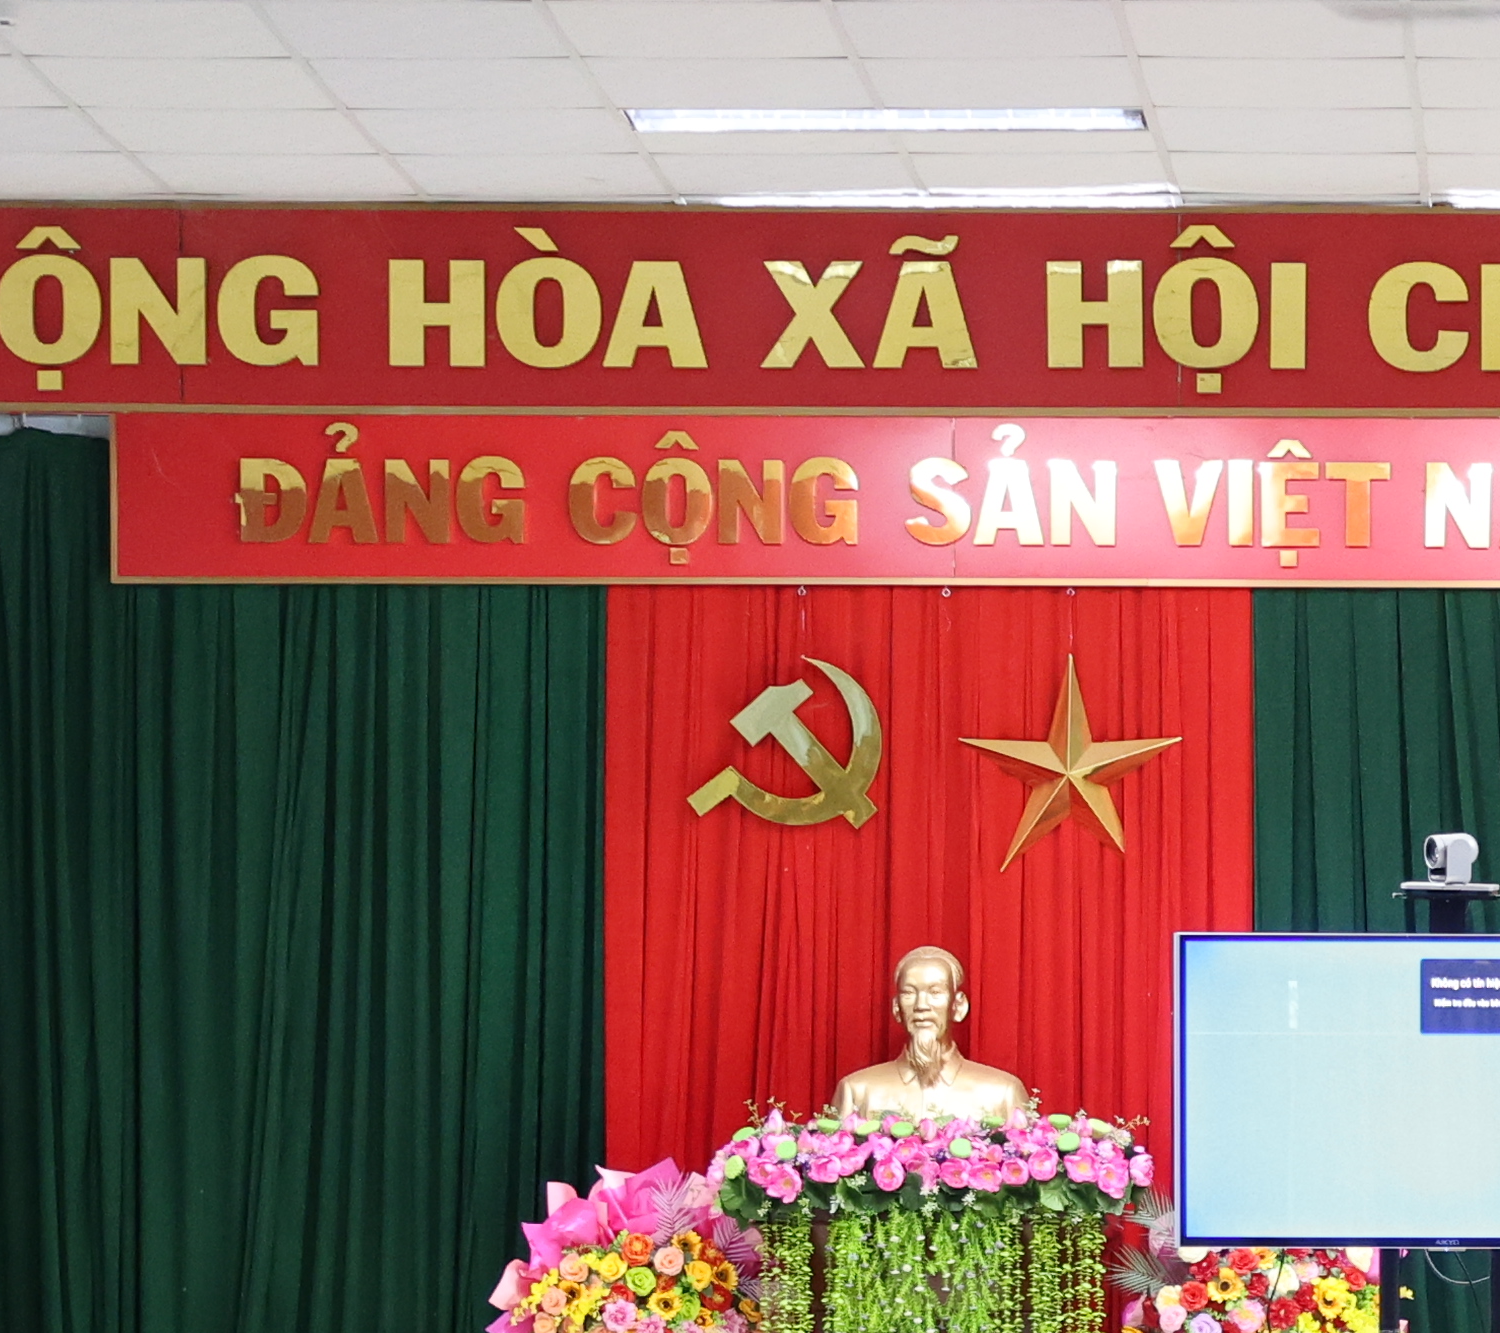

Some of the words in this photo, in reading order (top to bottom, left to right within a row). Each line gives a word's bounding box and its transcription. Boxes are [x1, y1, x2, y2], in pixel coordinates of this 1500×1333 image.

[388, 226, 704, 369] HÒA
[760, 234, 978, 369] XÃ
[1045, 224, 1307, 394] HỘI
[235, 421, 528, 545] ĐẢNG
[567, 430, 859, 565] CỘNG
[904, 423, 1117, 547] SẢN
[1152, 438, 1392, 568] VIỆT
